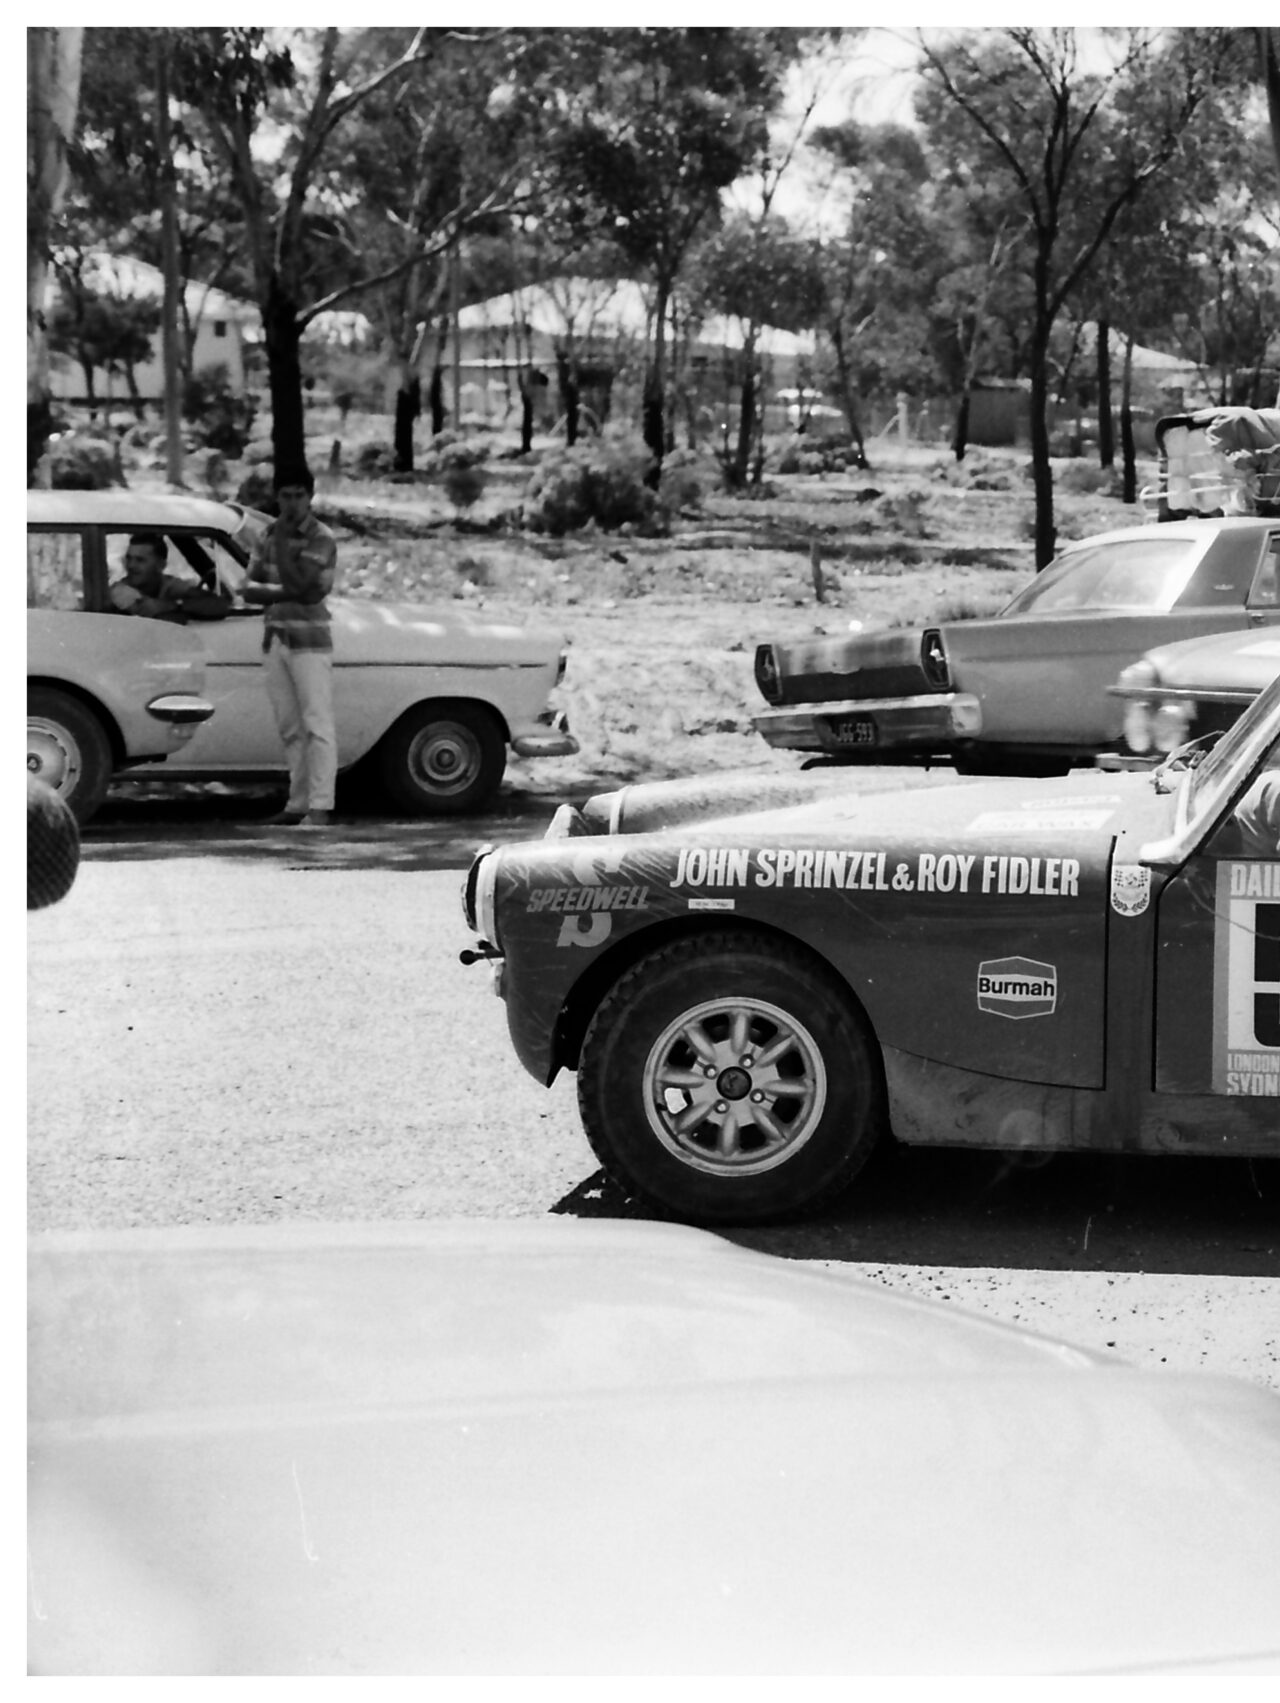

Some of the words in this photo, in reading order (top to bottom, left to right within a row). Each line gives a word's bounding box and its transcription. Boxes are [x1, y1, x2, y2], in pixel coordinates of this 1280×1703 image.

[670, 848, 749, 888] JOHN
[755, 849, 889, 891] SPRINZEL
[892, 863, 914, 891] &
[917, 853, 976, 893] ROY
[981, 855, 1080, 897] FIDLER
[526, 886, 650, 913] SPEEDWELL
[978, 977, 1056, 998] Burmah
